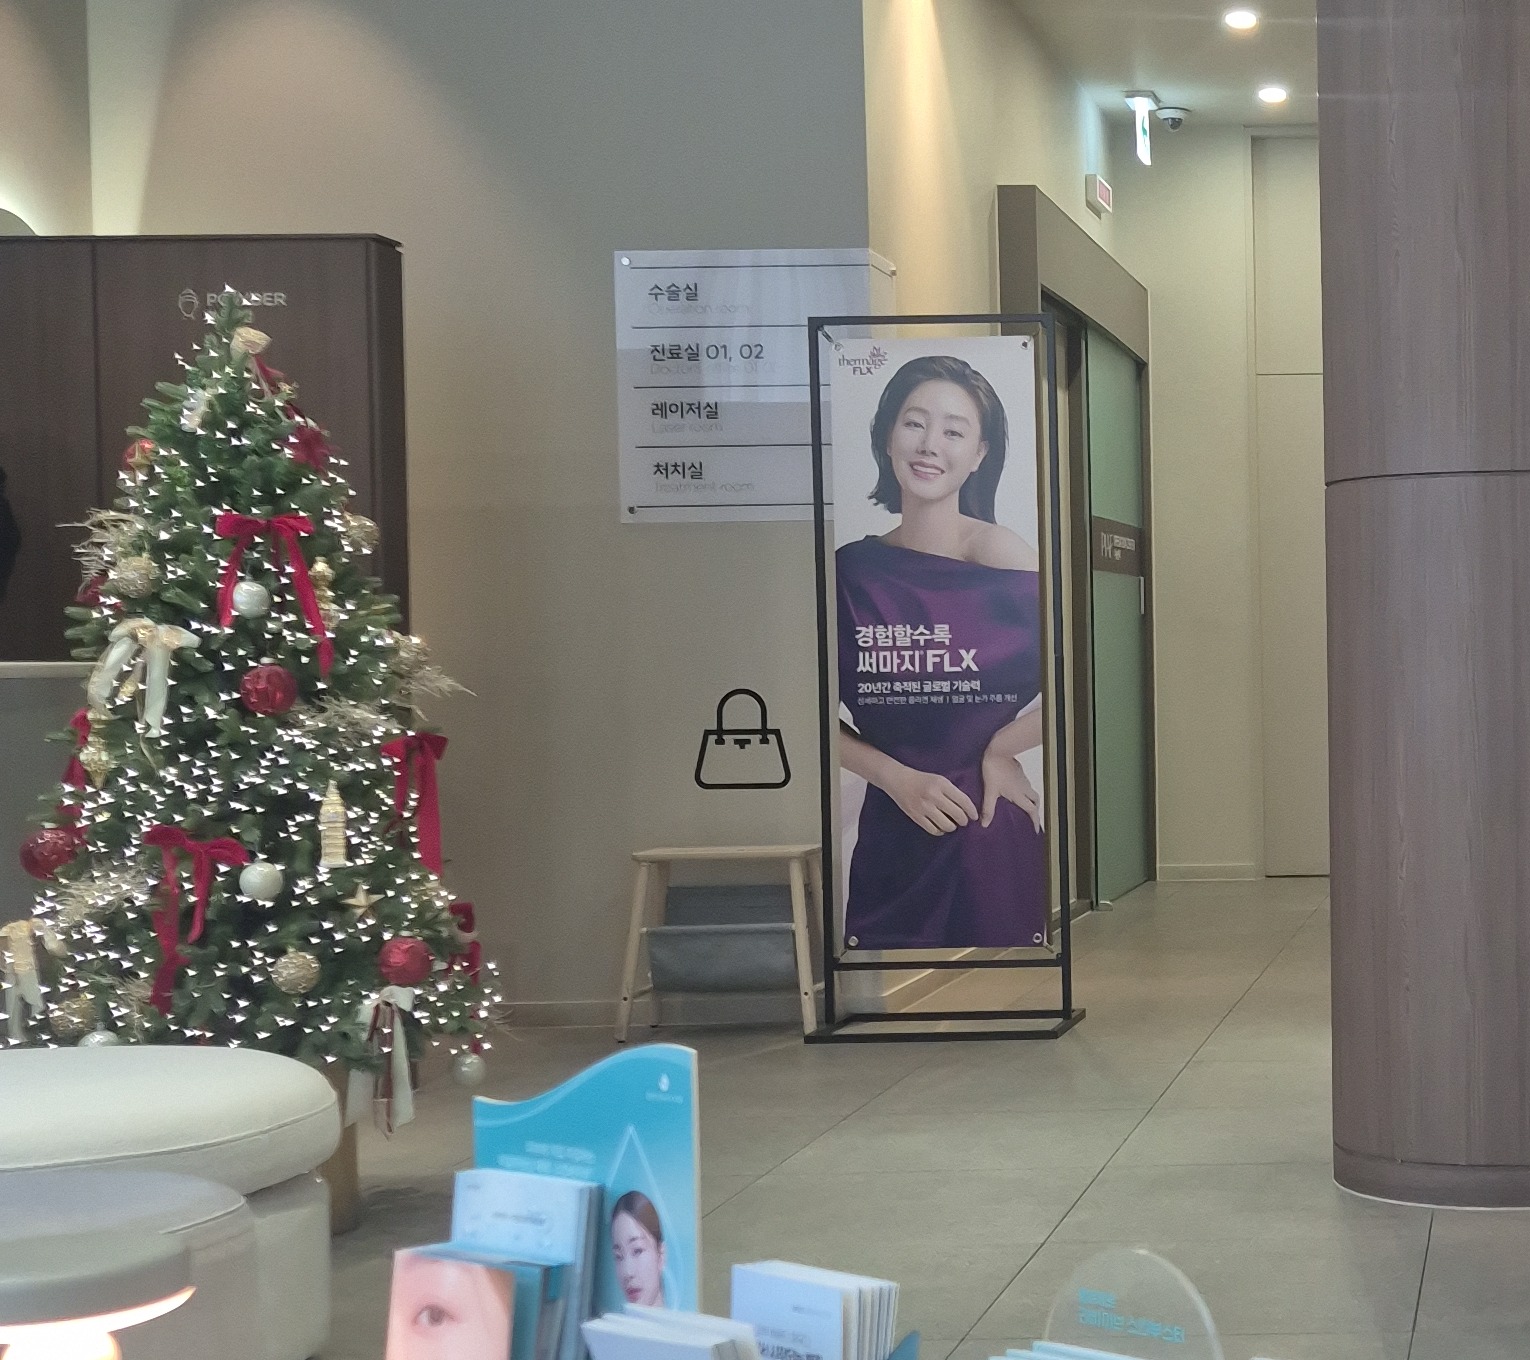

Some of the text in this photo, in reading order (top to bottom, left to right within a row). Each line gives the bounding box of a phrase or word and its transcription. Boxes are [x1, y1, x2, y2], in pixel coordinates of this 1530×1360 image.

[648, 282, 699, 301] 수술실
[650, 343, 764, 363] 진료실 01, 02
[852, 366, 874, 376] FLX
[651, 401, 720, 420] 레이저실
[653, 461, 704, 480] 처치실
[855, 624, 952, 647] 경험할수록
[926, 649, 980, 673] FLX
[857, 681, 892, 694] 20년간
